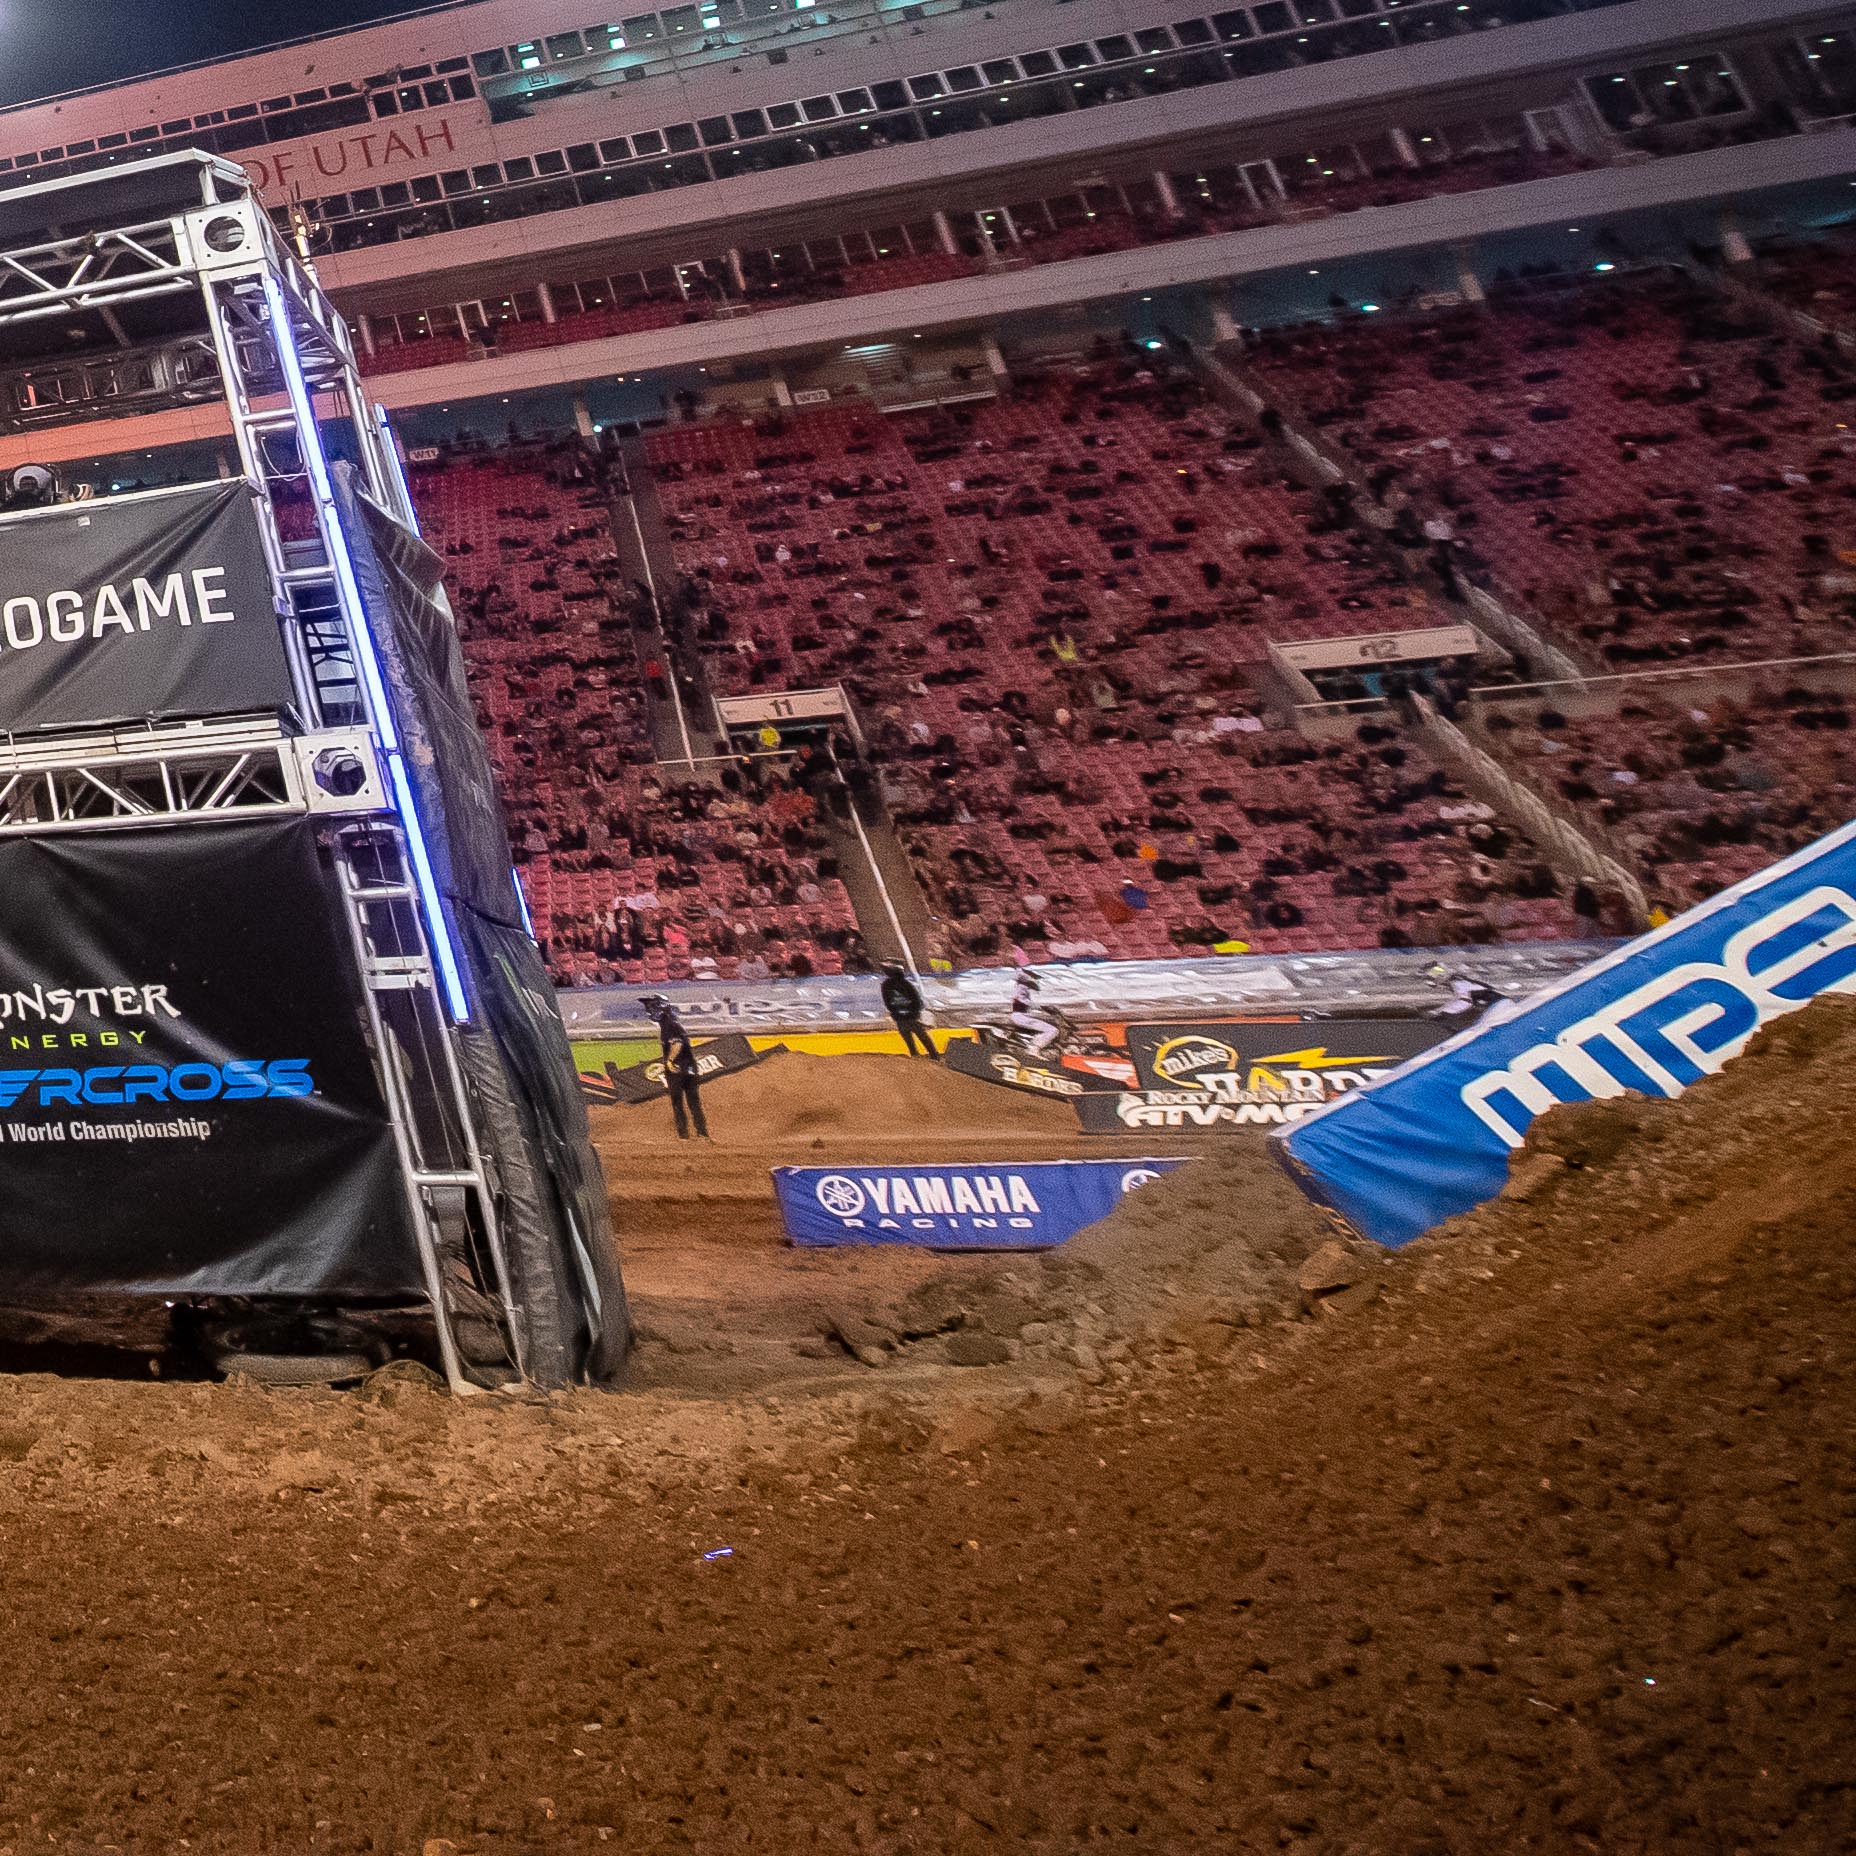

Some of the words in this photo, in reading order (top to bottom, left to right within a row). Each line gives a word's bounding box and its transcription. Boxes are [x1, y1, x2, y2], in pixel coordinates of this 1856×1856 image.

[313, 118, 456, 176] UTAH
[8, 1120, 65, 1143] World
[68, 1118, 212, 1142] Championship
[859, 1175, 1041, 1215] YAMAHA
[843, 1216, 1034, 1229] RACING
